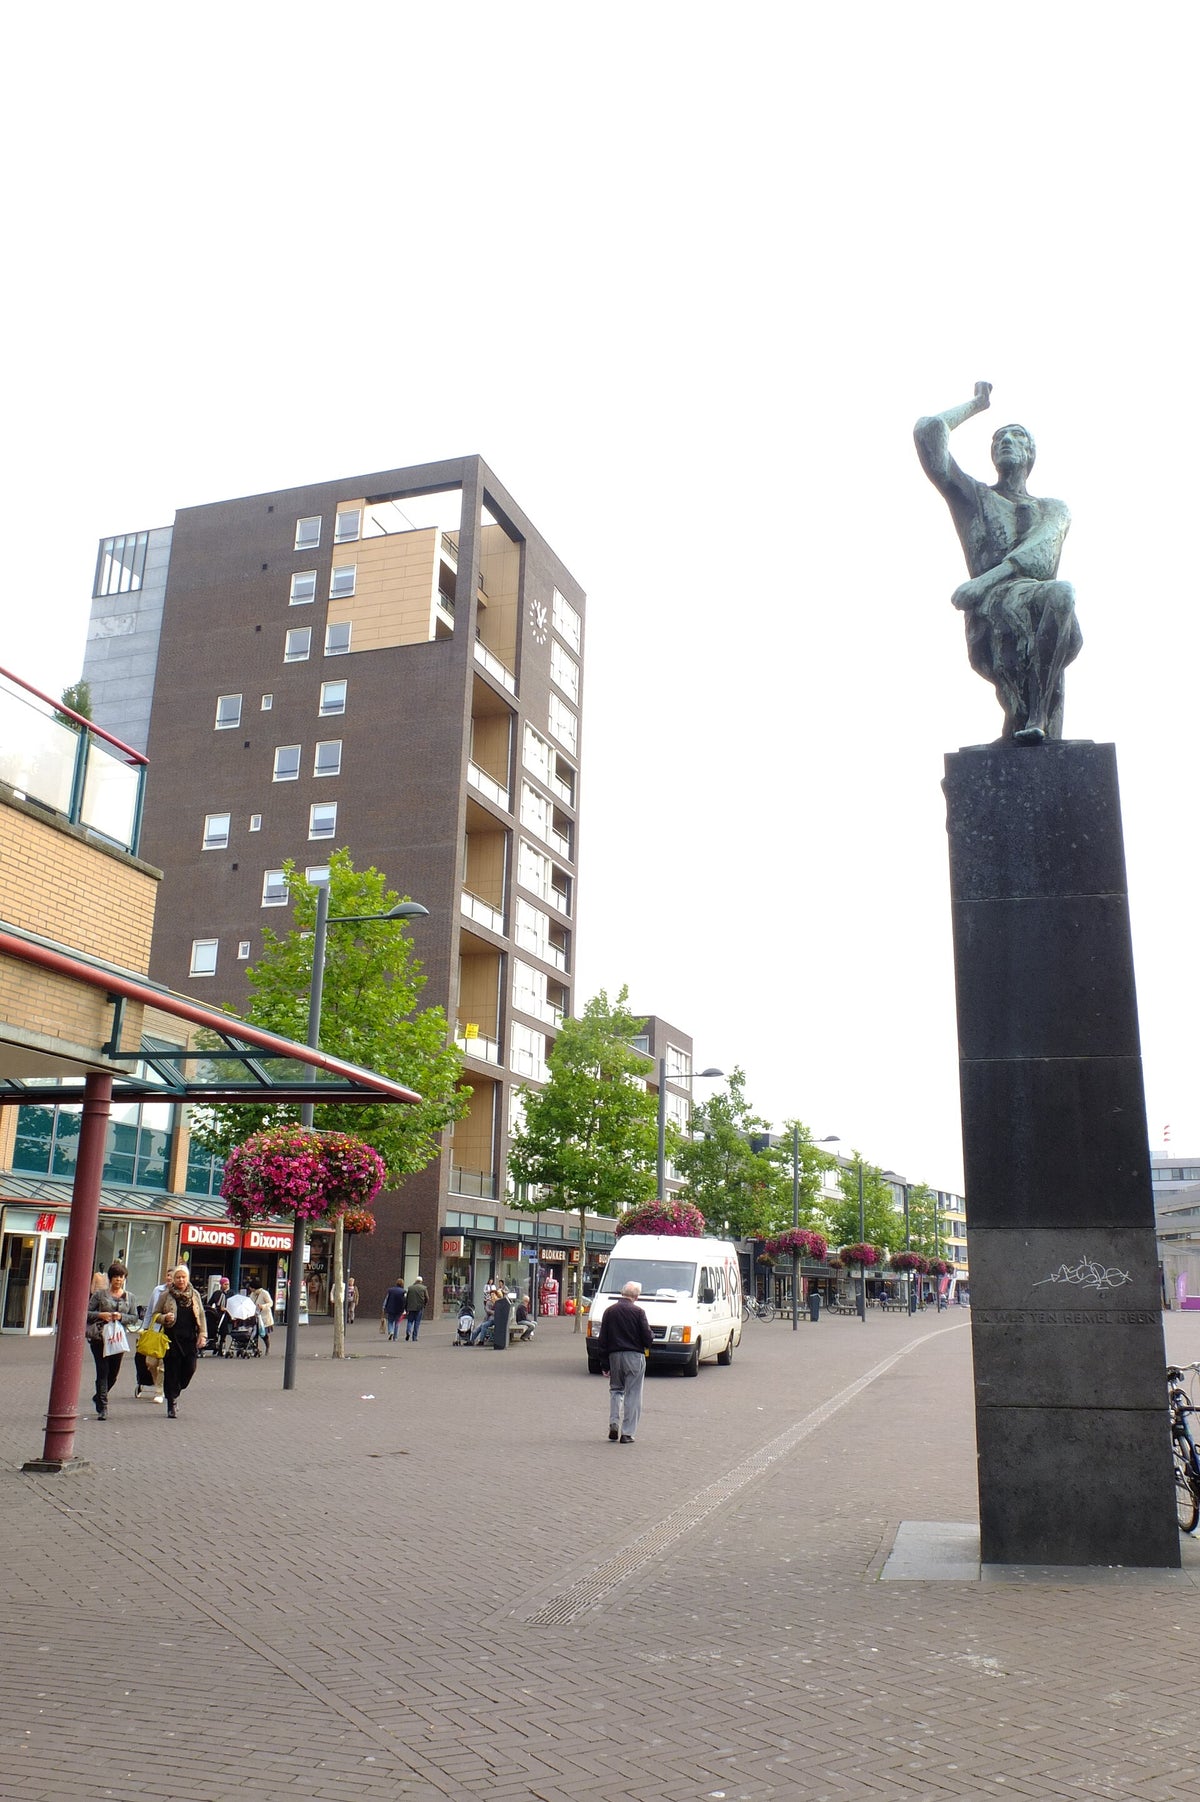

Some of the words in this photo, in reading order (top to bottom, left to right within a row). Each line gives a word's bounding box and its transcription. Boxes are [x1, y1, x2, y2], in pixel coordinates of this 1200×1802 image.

[187, 1226, 235, 1245] Dixons
[250, 1231, 291, 1249] Dixons
[443, 1241, 460, 1252] DIDI
[541, 1249, 566, 1260] BLOKKER
[708, 1266, 726, 1301] DPD
